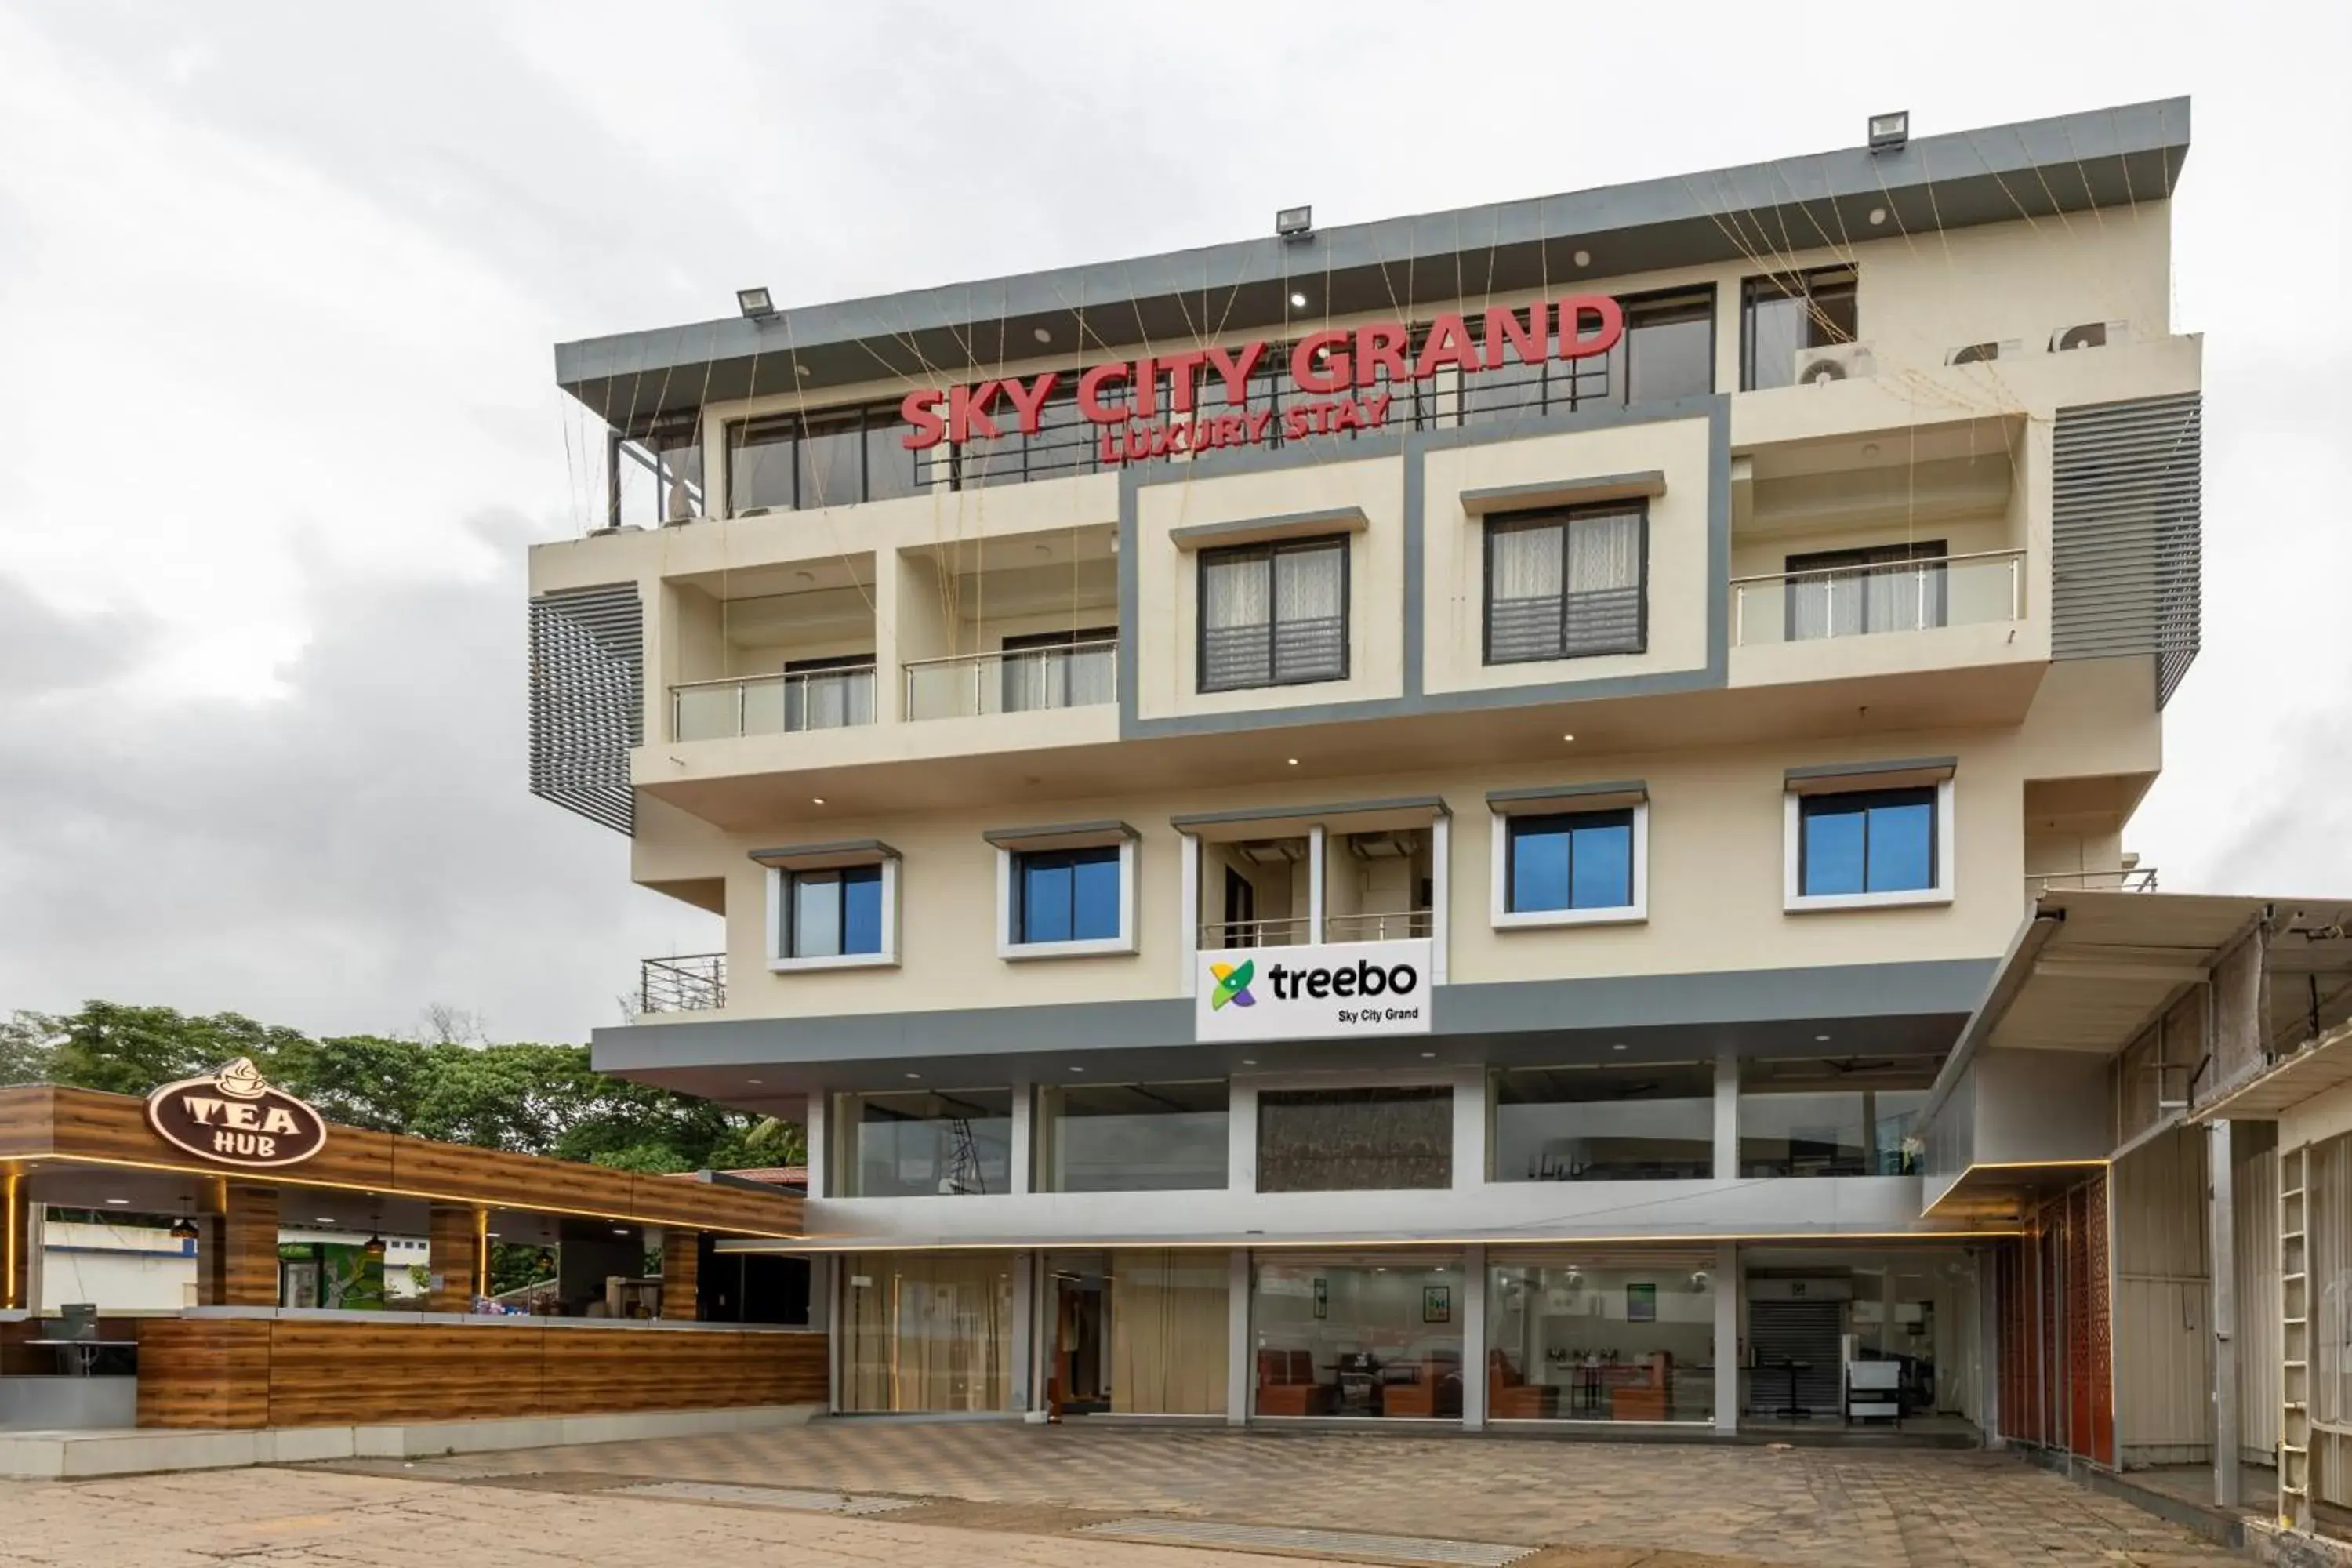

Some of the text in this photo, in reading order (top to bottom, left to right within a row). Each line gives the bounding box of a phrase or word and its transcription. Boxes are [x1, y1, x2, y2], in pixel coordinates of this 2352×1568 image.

[902, 293, 1624, 449] SKY CITY GRAND
[1102, 394, 1394, 463] LUXURY STAY
[1268, 959, 1417, 999] treebo
[1338, 1007, 1418, 1023] Sky City Grand
[183, 1096, 302, 1134] TEA
[212, 1131, 276, 1157] HUB
